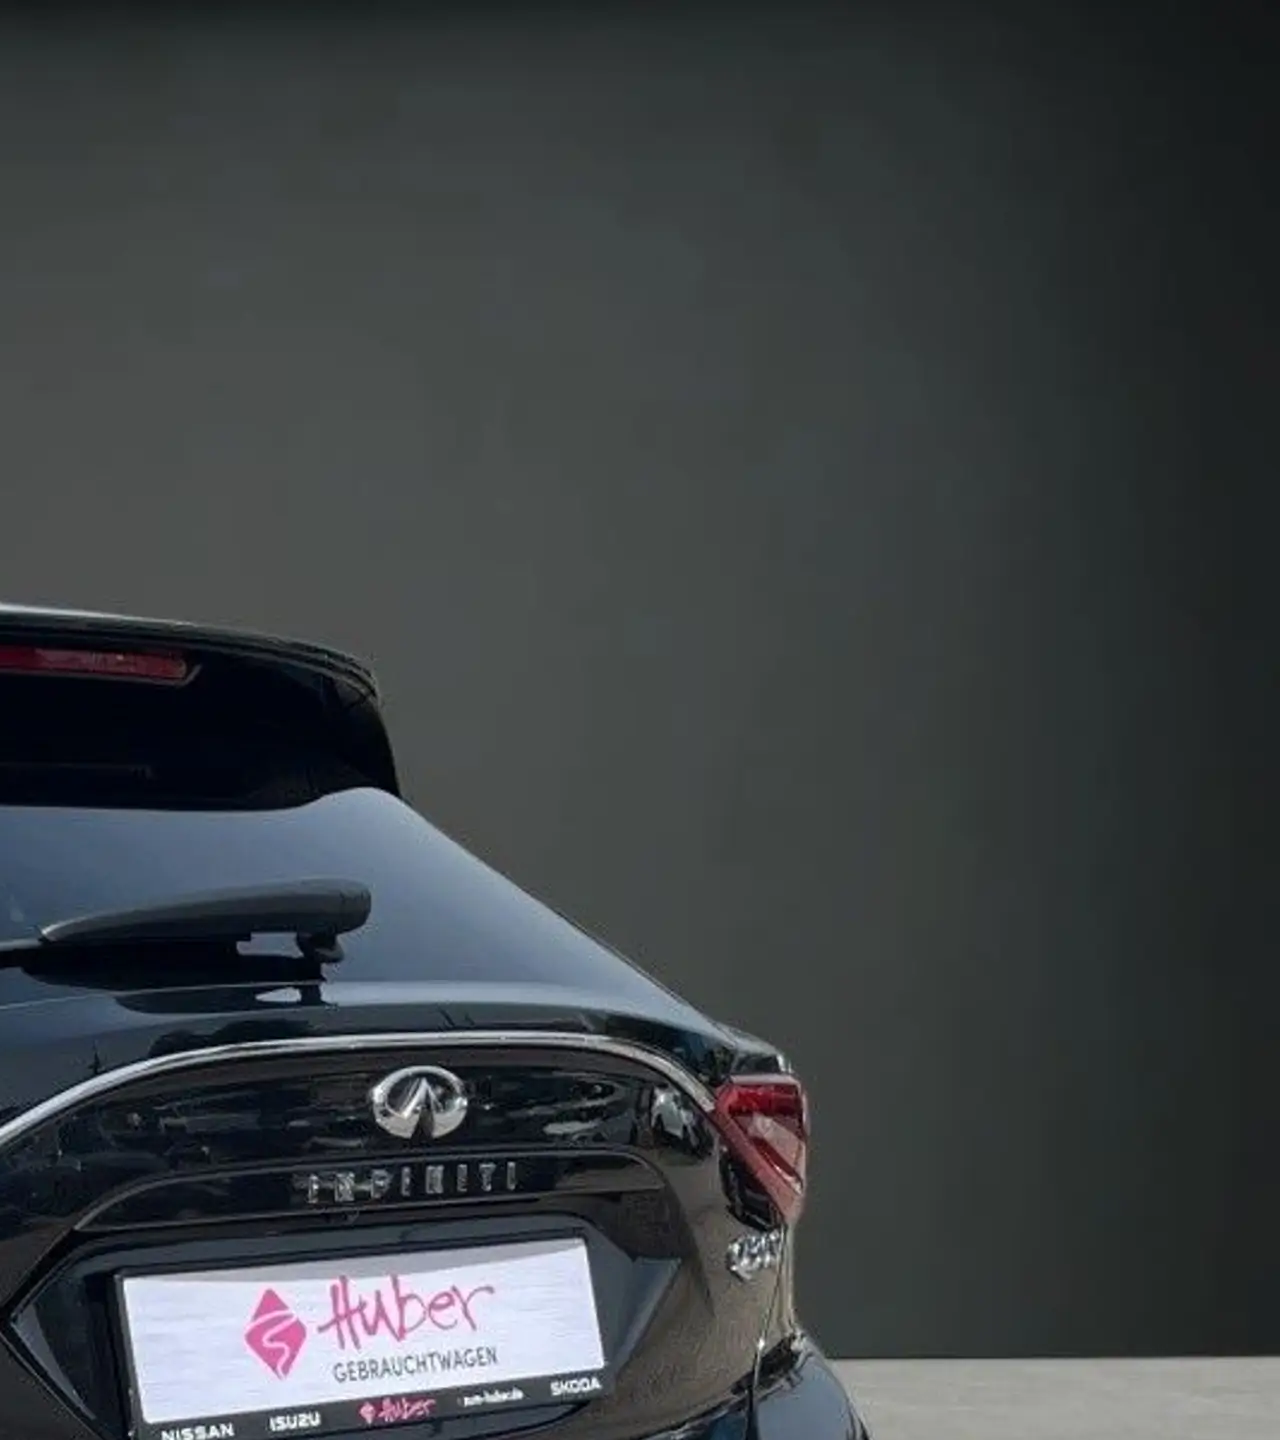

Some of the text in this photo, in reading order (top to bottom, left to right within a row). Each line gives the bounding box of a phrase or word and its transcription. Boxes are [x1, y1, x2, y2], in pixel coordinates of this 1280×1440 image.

[317, 1274, 496, 1350] Huber
[332, 1345, 499, 1384] GEBRAUCHTWAGEN
[268, 1410, 322, 1432] ISUZU
